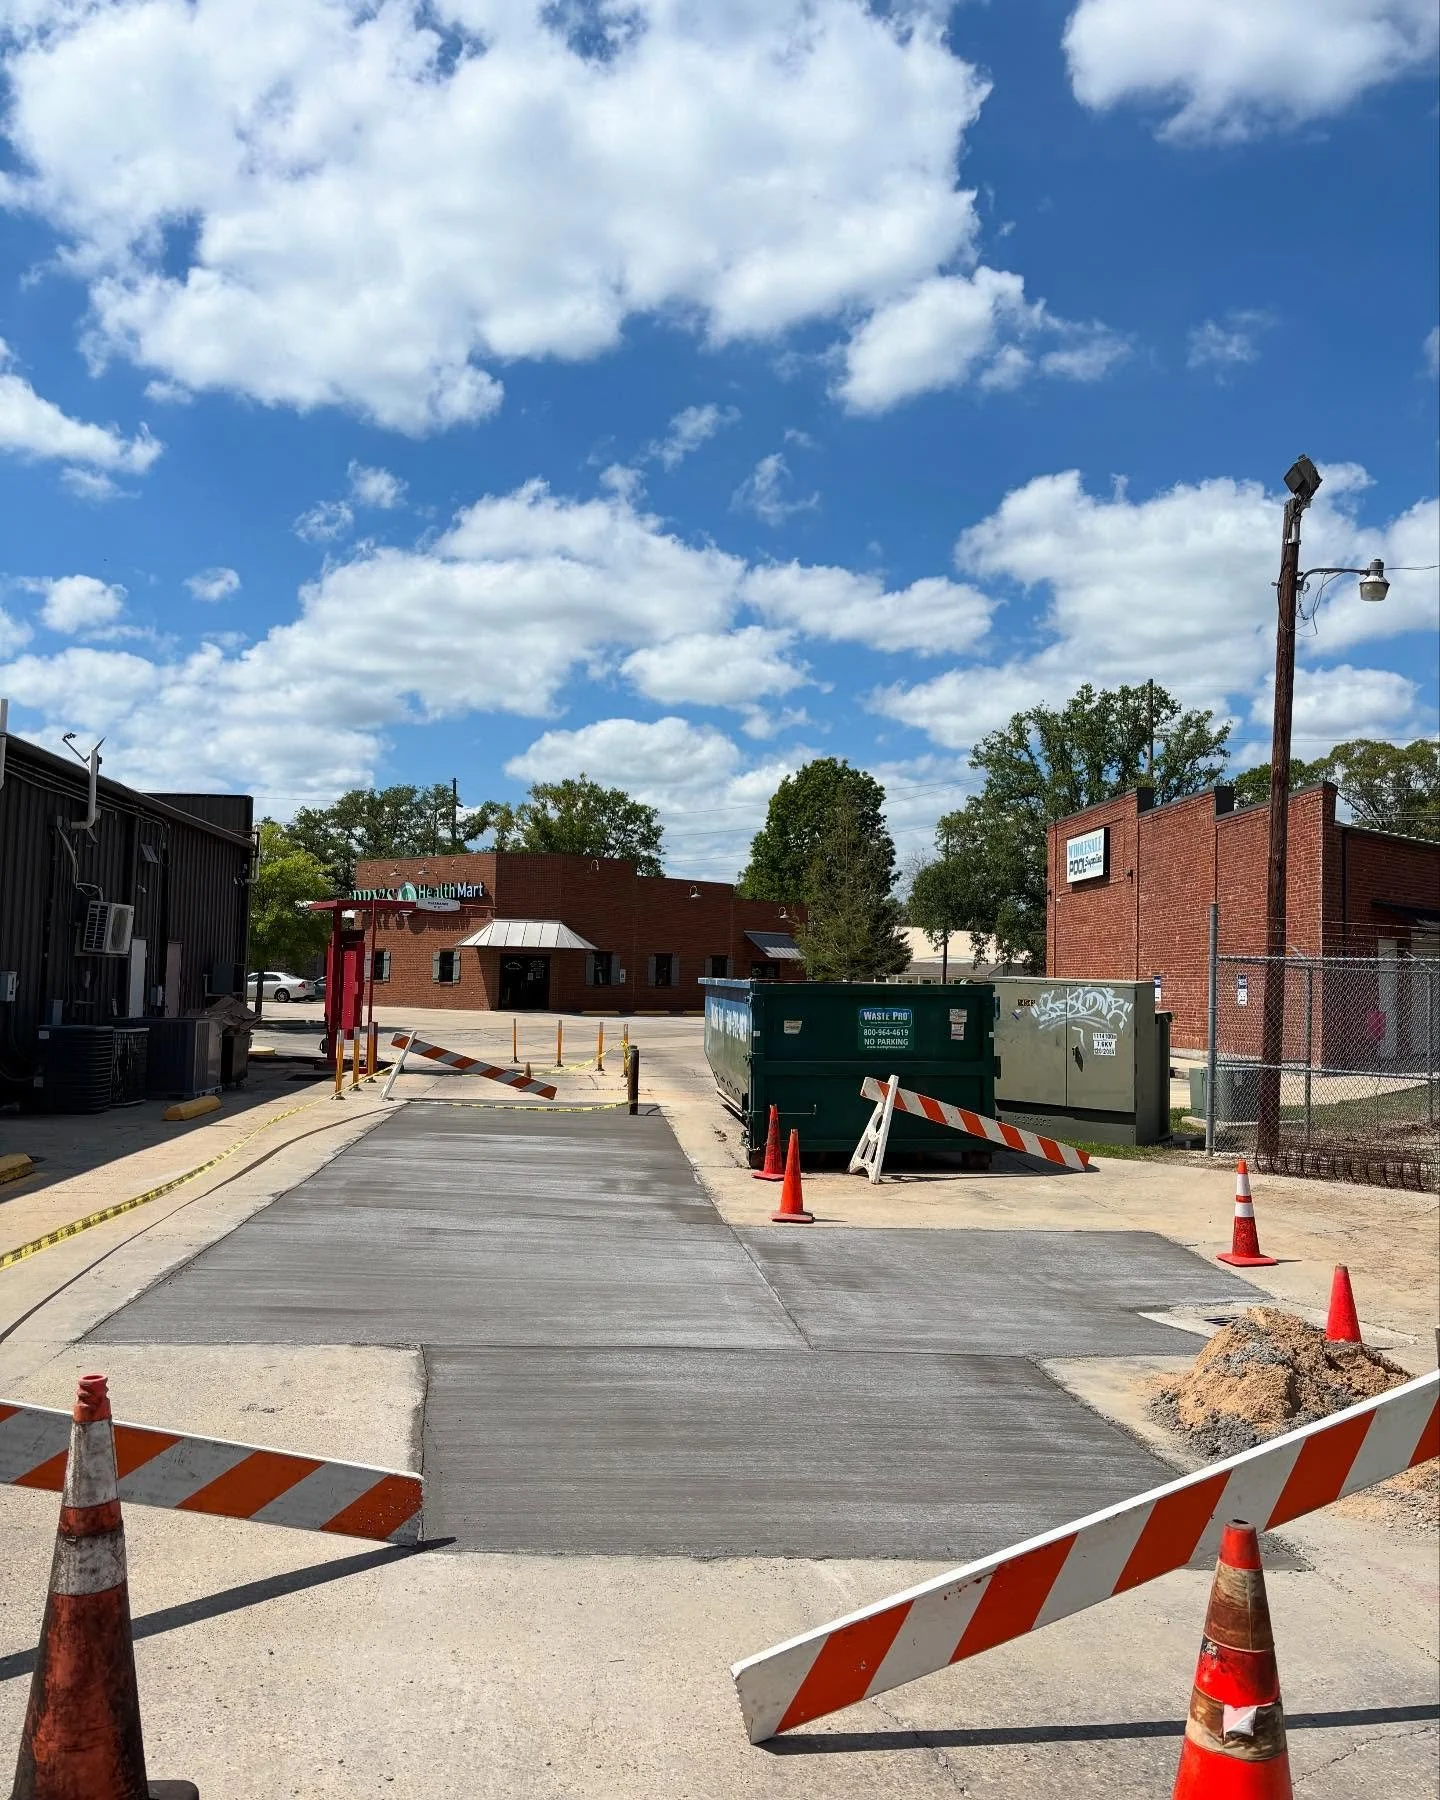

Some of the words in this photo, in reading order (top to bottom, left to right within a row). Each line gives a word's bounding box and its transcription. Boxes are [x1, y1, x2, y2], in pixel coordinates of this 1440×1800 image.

[1068, 836, 1102, 858] WHOLESALE
[1069, 857, 1086, 876] POOL
[418, 882, 455, 899] Health
[457, 881, 483, 898] Mart
[863, 1011, 890, 1021] WASTE
[892, 1011, 908, 1021] PRO
[863, 1028, 909, 1036] 800-964-4619
[864, 1038, 875, 1046] NO
[877, 1038, 909, 1046] PARKING
